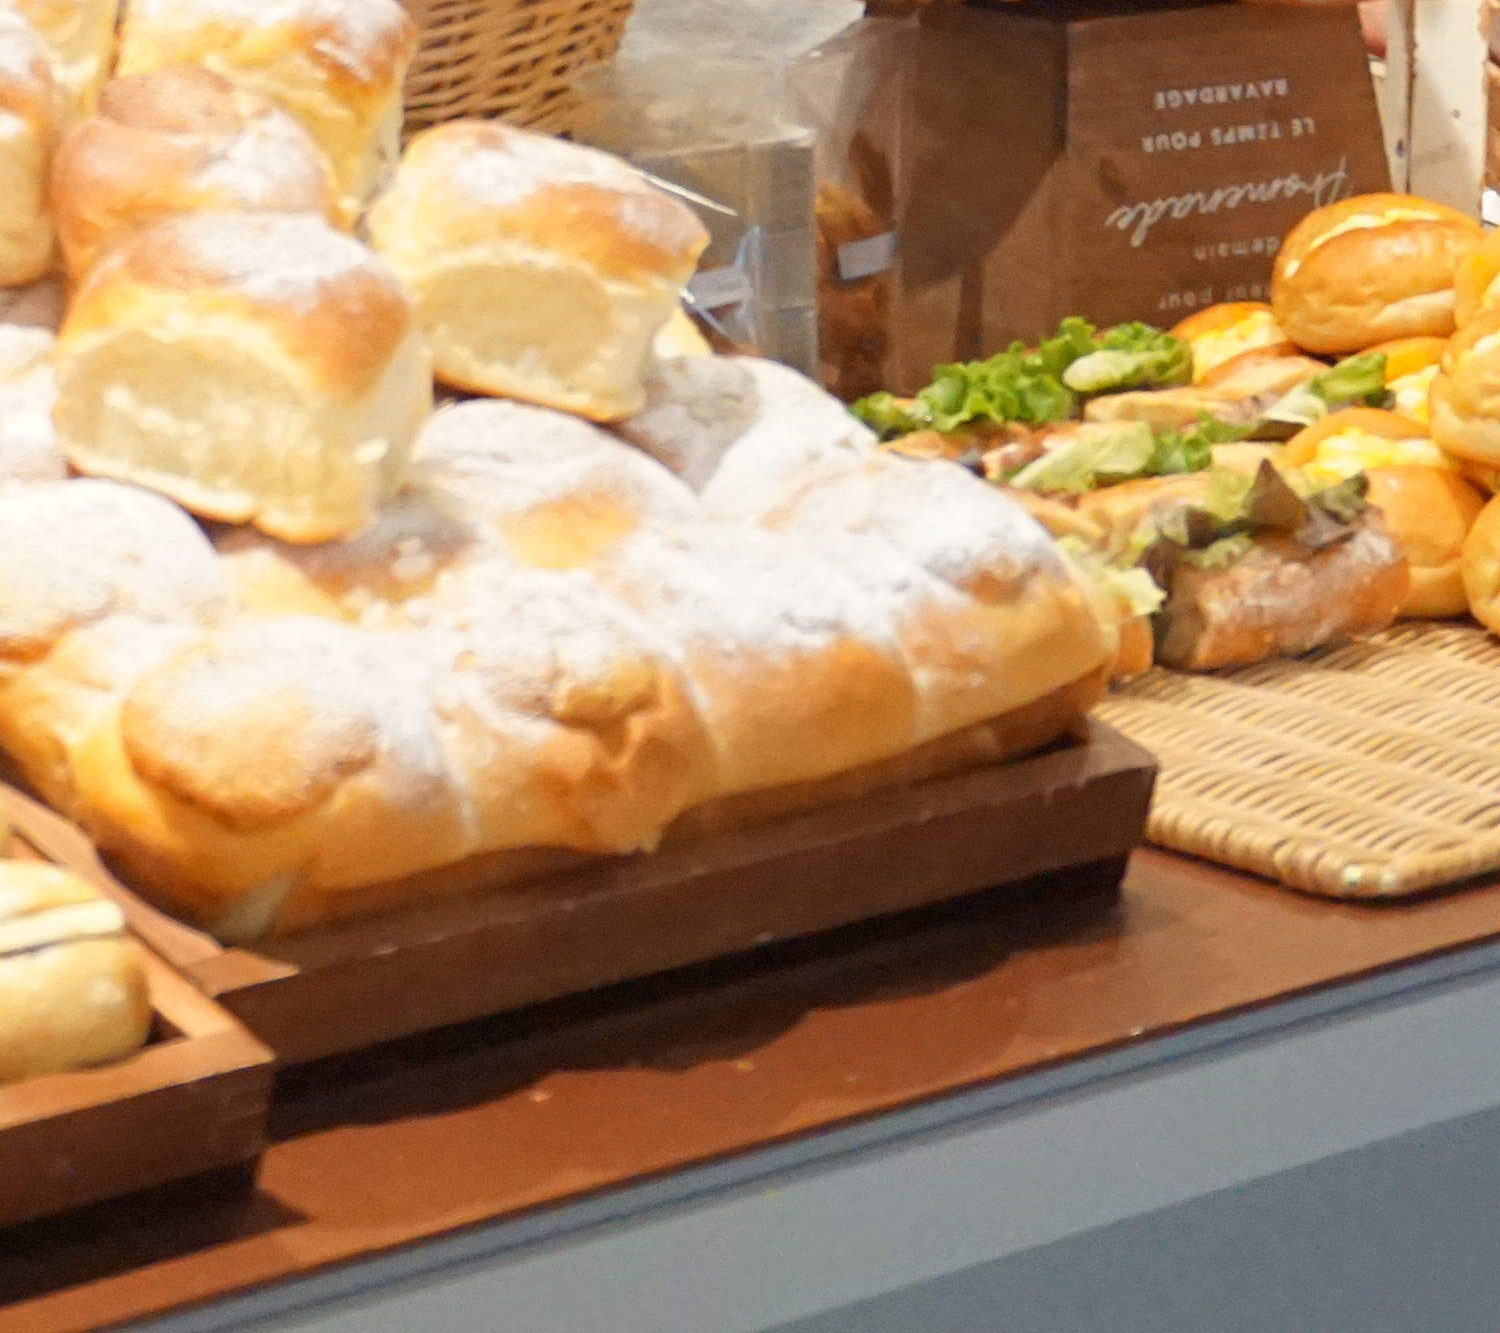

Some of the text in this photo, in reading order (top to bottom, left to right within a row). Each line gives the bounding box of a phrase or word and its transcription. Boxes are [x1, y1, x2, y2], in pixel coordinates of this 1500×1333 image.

[1152, 78, 1288, 110] BAVARDAGE
[1141, 116, 1316, 153] LE TEMPS POUR
